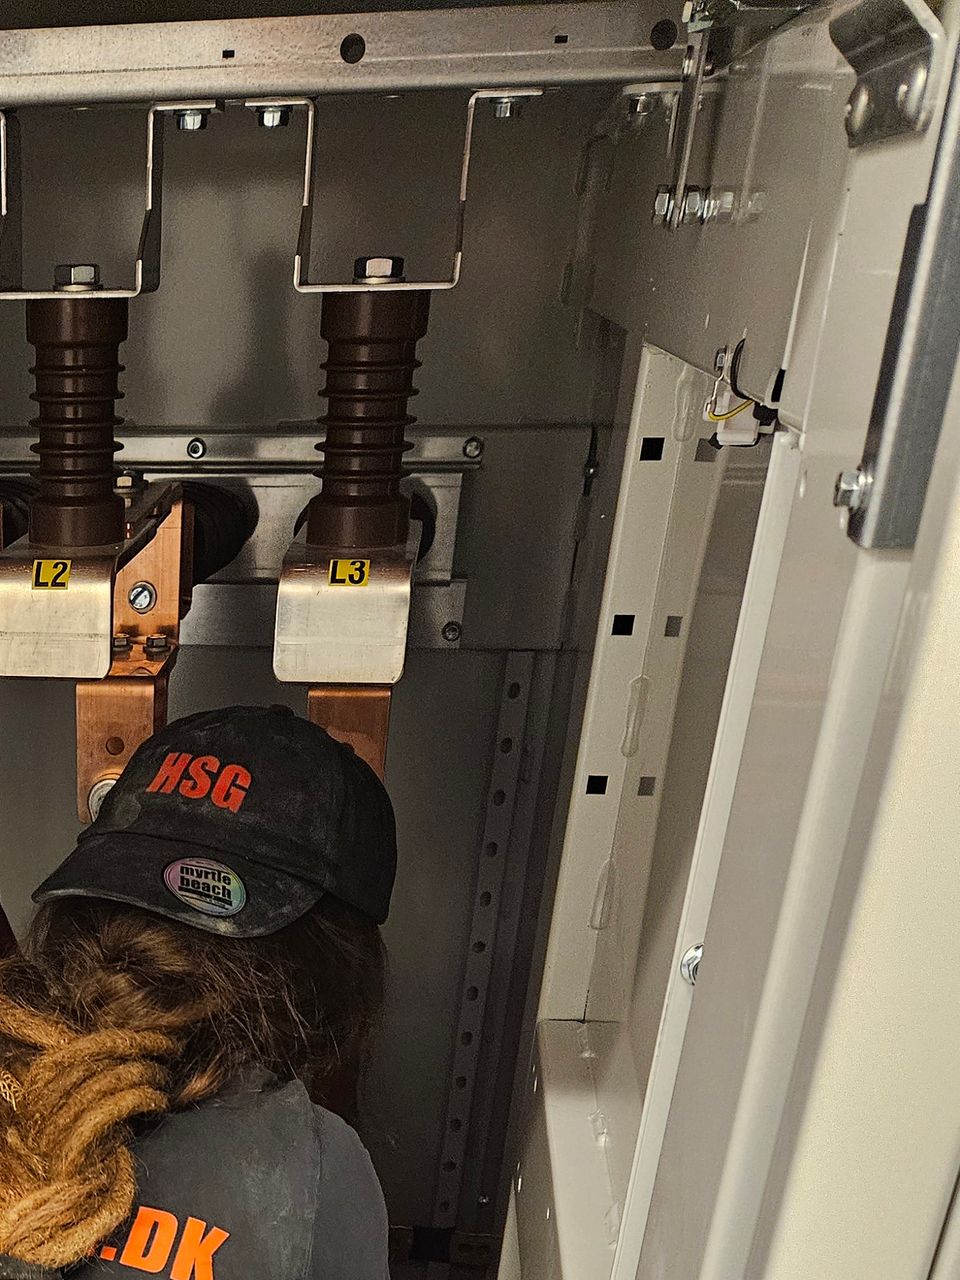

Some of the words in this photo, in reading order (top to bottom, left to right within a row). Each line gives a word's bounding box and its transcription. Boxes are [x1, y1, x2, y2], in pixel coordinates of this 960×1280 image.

[34, 561, 68, 587] L2
[330, 560, 366, 584] L3
[145, 752, 253, 813] HSG
[180, 866, 232, 885] myrtle
[180, 876, 232, 899] beach
